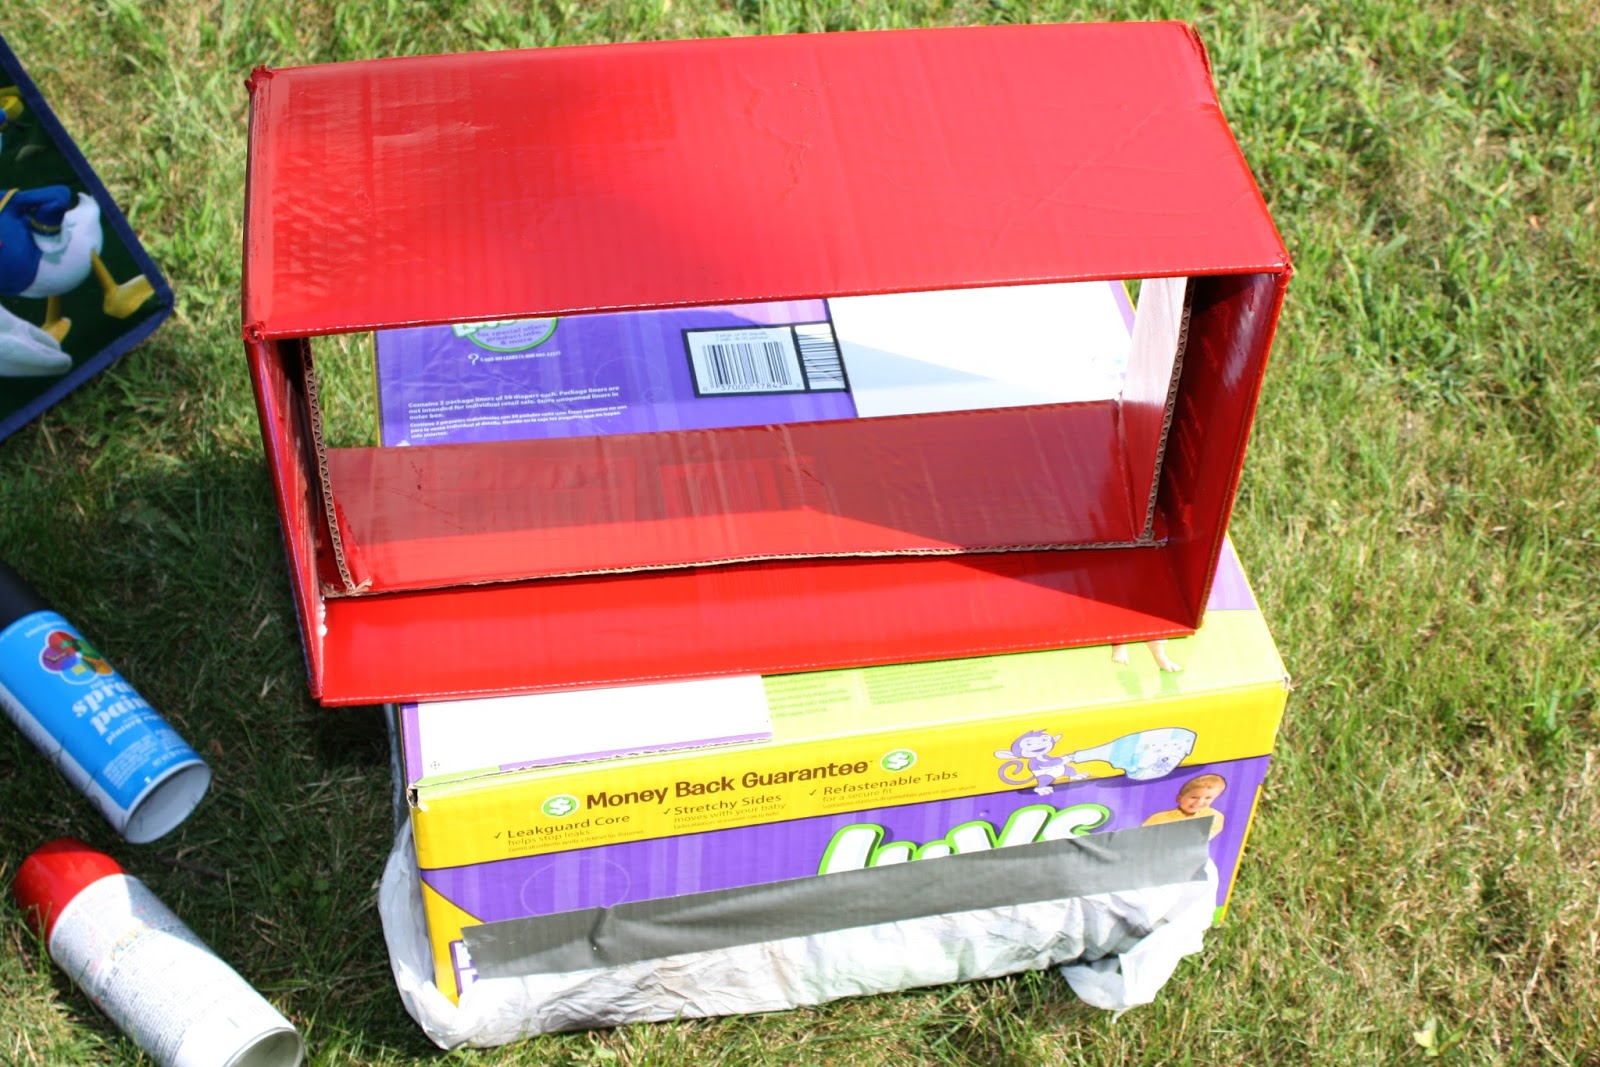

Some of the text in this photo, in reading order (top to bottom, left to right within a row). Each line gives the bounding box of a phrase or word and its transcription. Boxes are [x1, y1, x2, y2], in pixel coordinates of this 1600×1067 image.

[486, 332, 522, 342] product
[492, 328, 520, 337] special
[422, 405, 454, 413] intended
[466, 400, 500, 409] individual
[446, 398, 474, 406] package
[559, 388, 588, 396] Package
[72, 682, 133, 718] spra
[90, 695, 150, 736] pain
[586, 787, 668, 810] Money
[676, 777, 735, 798] Back
[742, 760, 868, 788] Guarantee
[823, 771, 958, 796] Refastenable Tabs
[848, 790, 880, 799] secure
[674, 794, 782, 816] Stretchy Sides
[674, 802, 786, 824] moves with your baby
[508, 815, 630, 838] Leakguard Core
[508, 829, 590, 846] helps stop leaks
